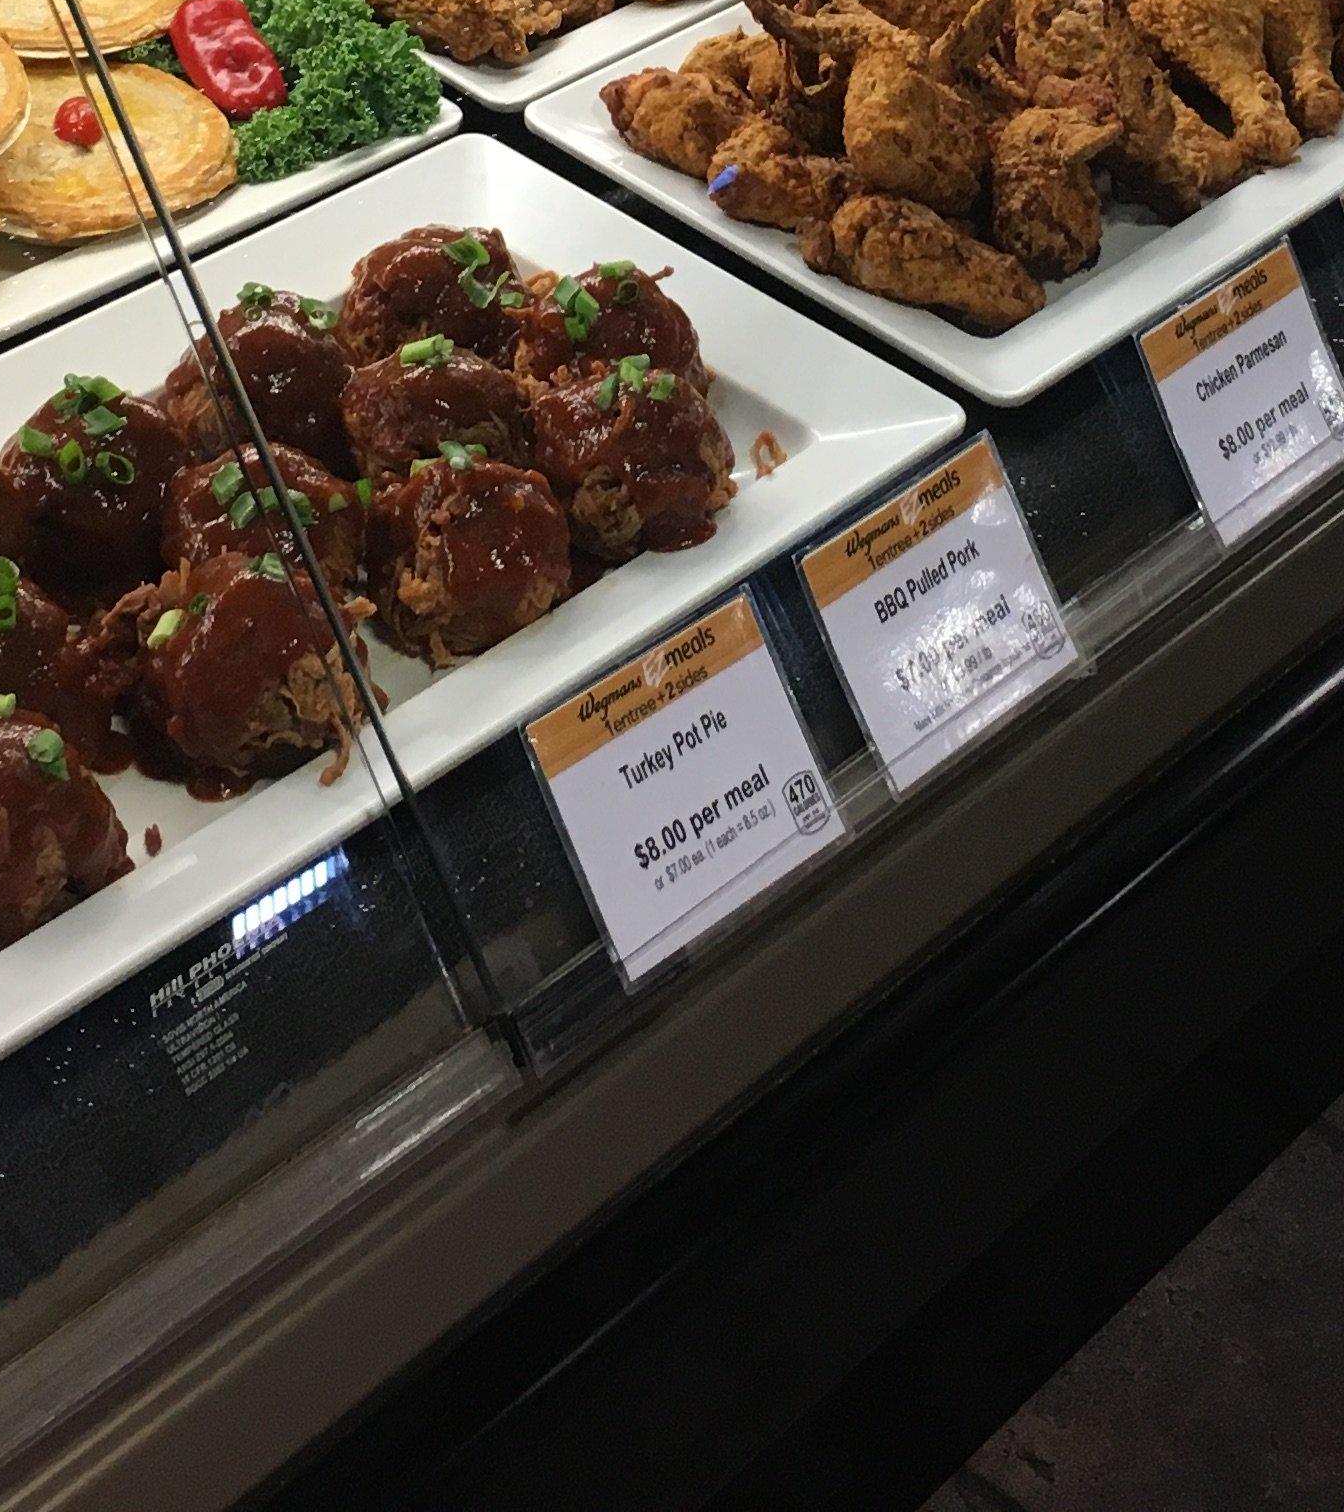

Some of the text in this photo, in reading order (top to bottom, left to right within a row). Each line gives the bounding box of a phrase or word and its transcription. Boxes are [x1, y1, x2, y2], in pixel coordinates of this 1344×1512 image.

[1196, 331, 1287, 402] Chicken Parmesan
[1219, 421, 1255, 461] $8.00
[1255, 407, 1277, 439] per
[1278, 381, 1309, 417] meal
[844, 515, 900, 558] Wegmans
[874, 539, 980, 623] BBQ Pulled Pork
[896, 646, 939, 690] $7.00
[944, 630, 970, 661] per
[972, 594, 1010, 635] meal
[577, 676, 642, 722] Wegmans
[618, 712, 727, 789] Turkey Pot Pie
[634, 764, 770, 870] $8.00 per meal
[789, 774, 816, 803] 470
[654, 876, 664, 891] or
[665, 855, 692, 883] $7.00
[716, 826, 738, 849] each
